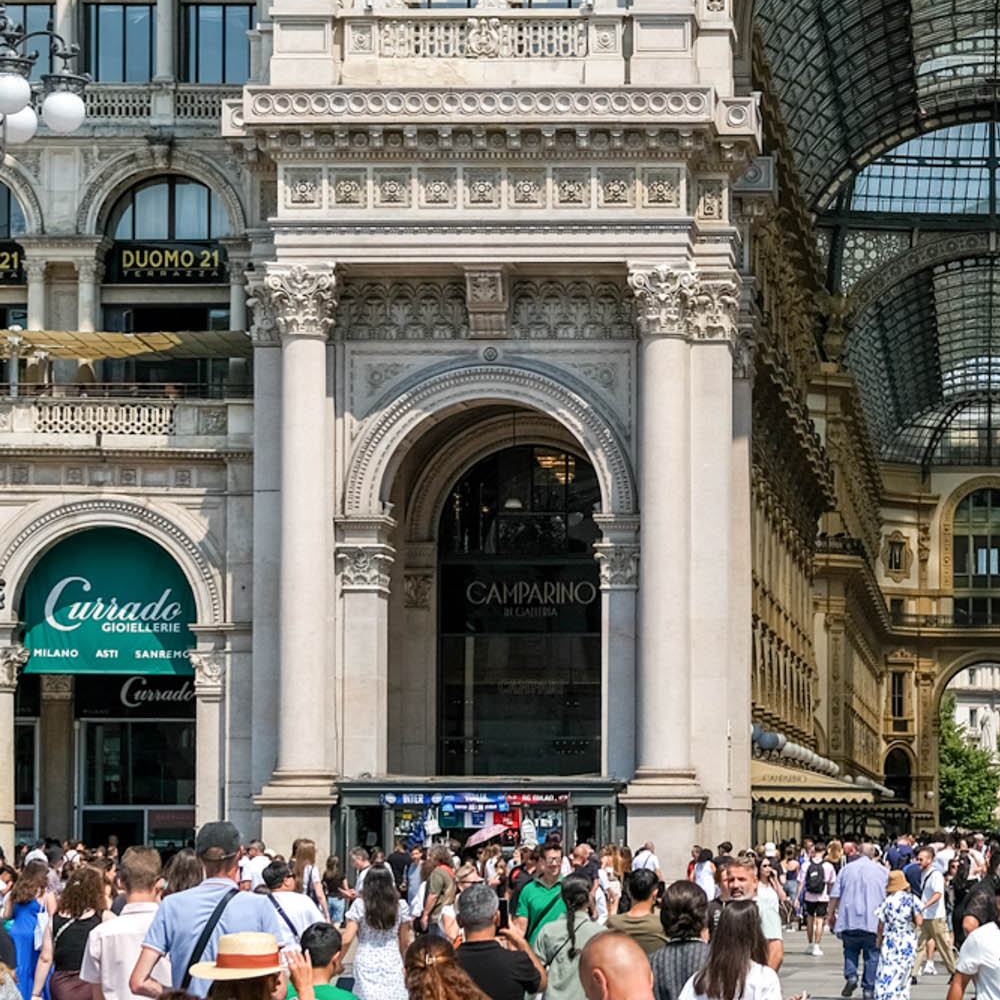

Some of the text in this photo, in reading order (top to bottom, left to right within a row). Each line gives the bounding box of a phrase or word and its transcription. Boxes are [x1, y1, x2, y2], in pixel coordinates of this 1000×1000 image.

[122, 250, 220, 268] DUOMO 21
[122, 270, 219, 278] TERRAZZA
[466, 581, 596, 604] CAMPARINO
[44, 576, 182, 632] Currado
[101, 622, 181, 633] GIOIELLERIE
[33, 648, 190, 660] MILANO ASTI SANREMO
[120, 676, 195, 708] Currado
